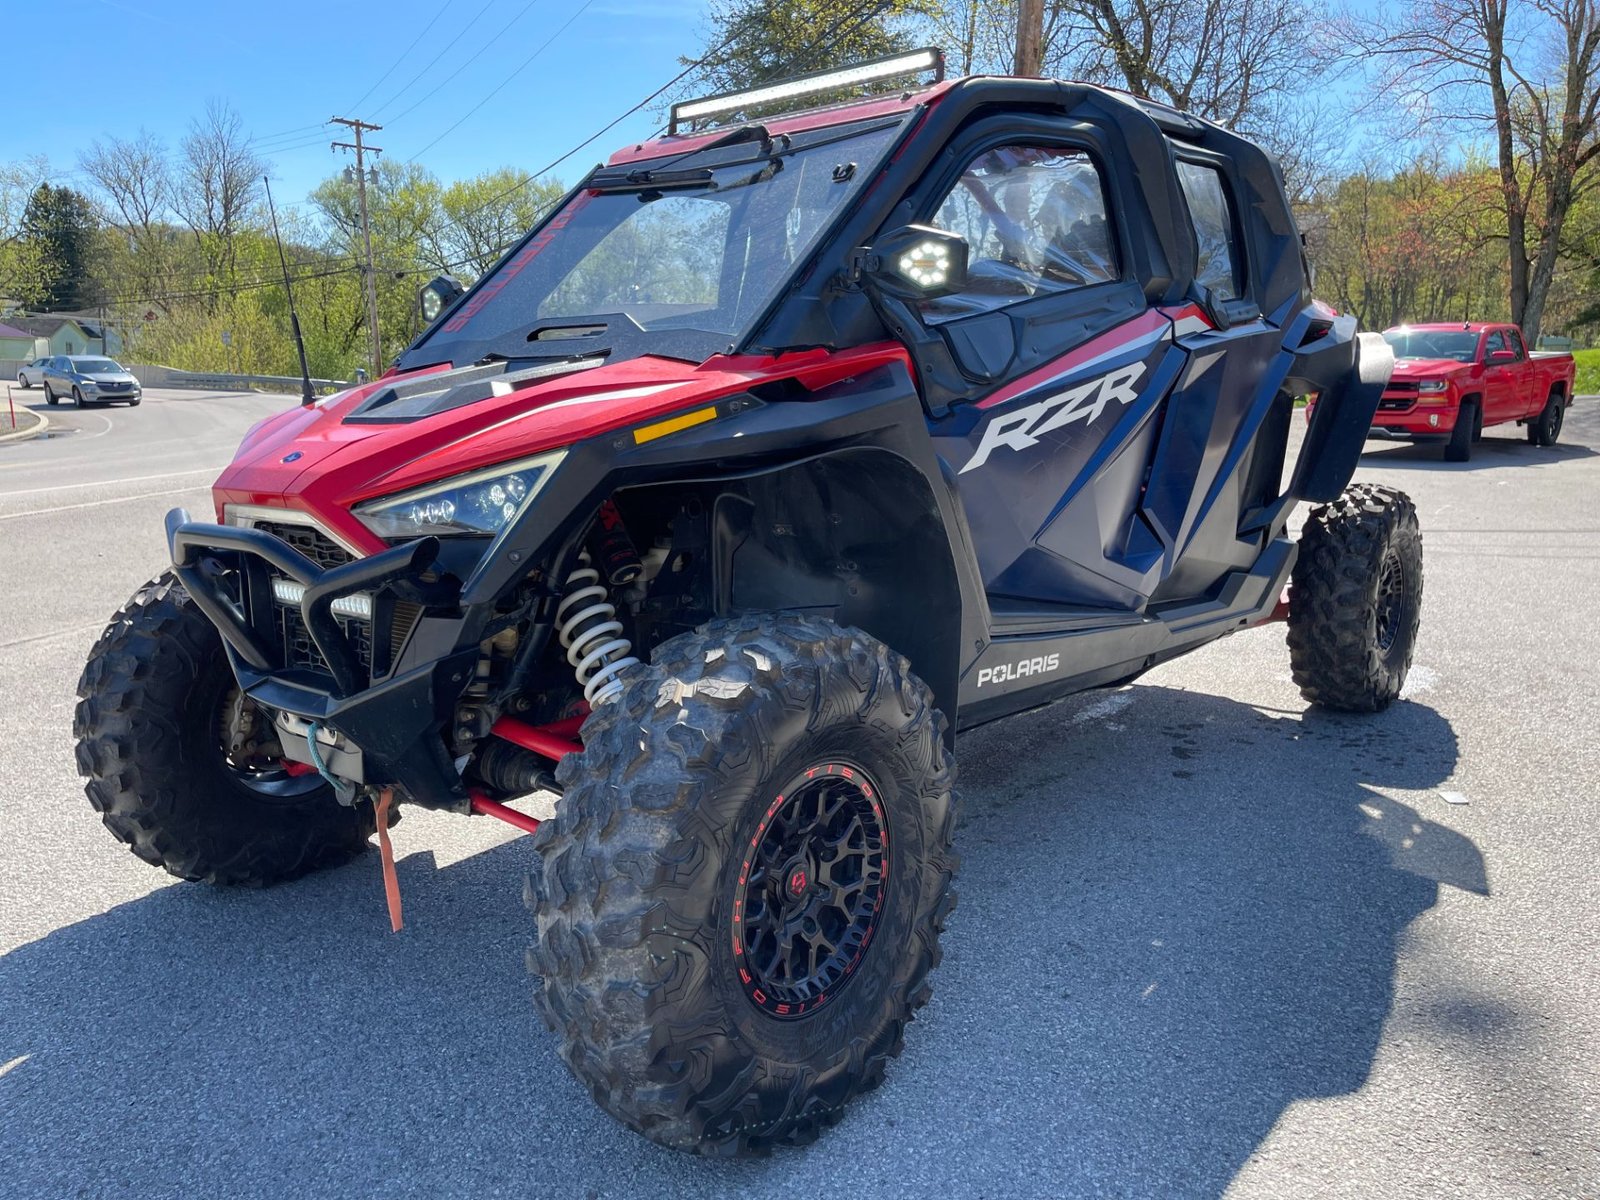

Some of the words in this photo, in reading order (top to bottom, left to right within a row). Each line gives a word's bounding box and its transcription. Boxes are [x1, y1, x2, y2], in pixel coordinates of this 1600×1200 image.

[958, 361, 1147, 474] RZR
[977, 653, 1060, 688] POLARIS
[803, 764, 855, 781] TIS
[775, 994, 827, 1014] TIS
